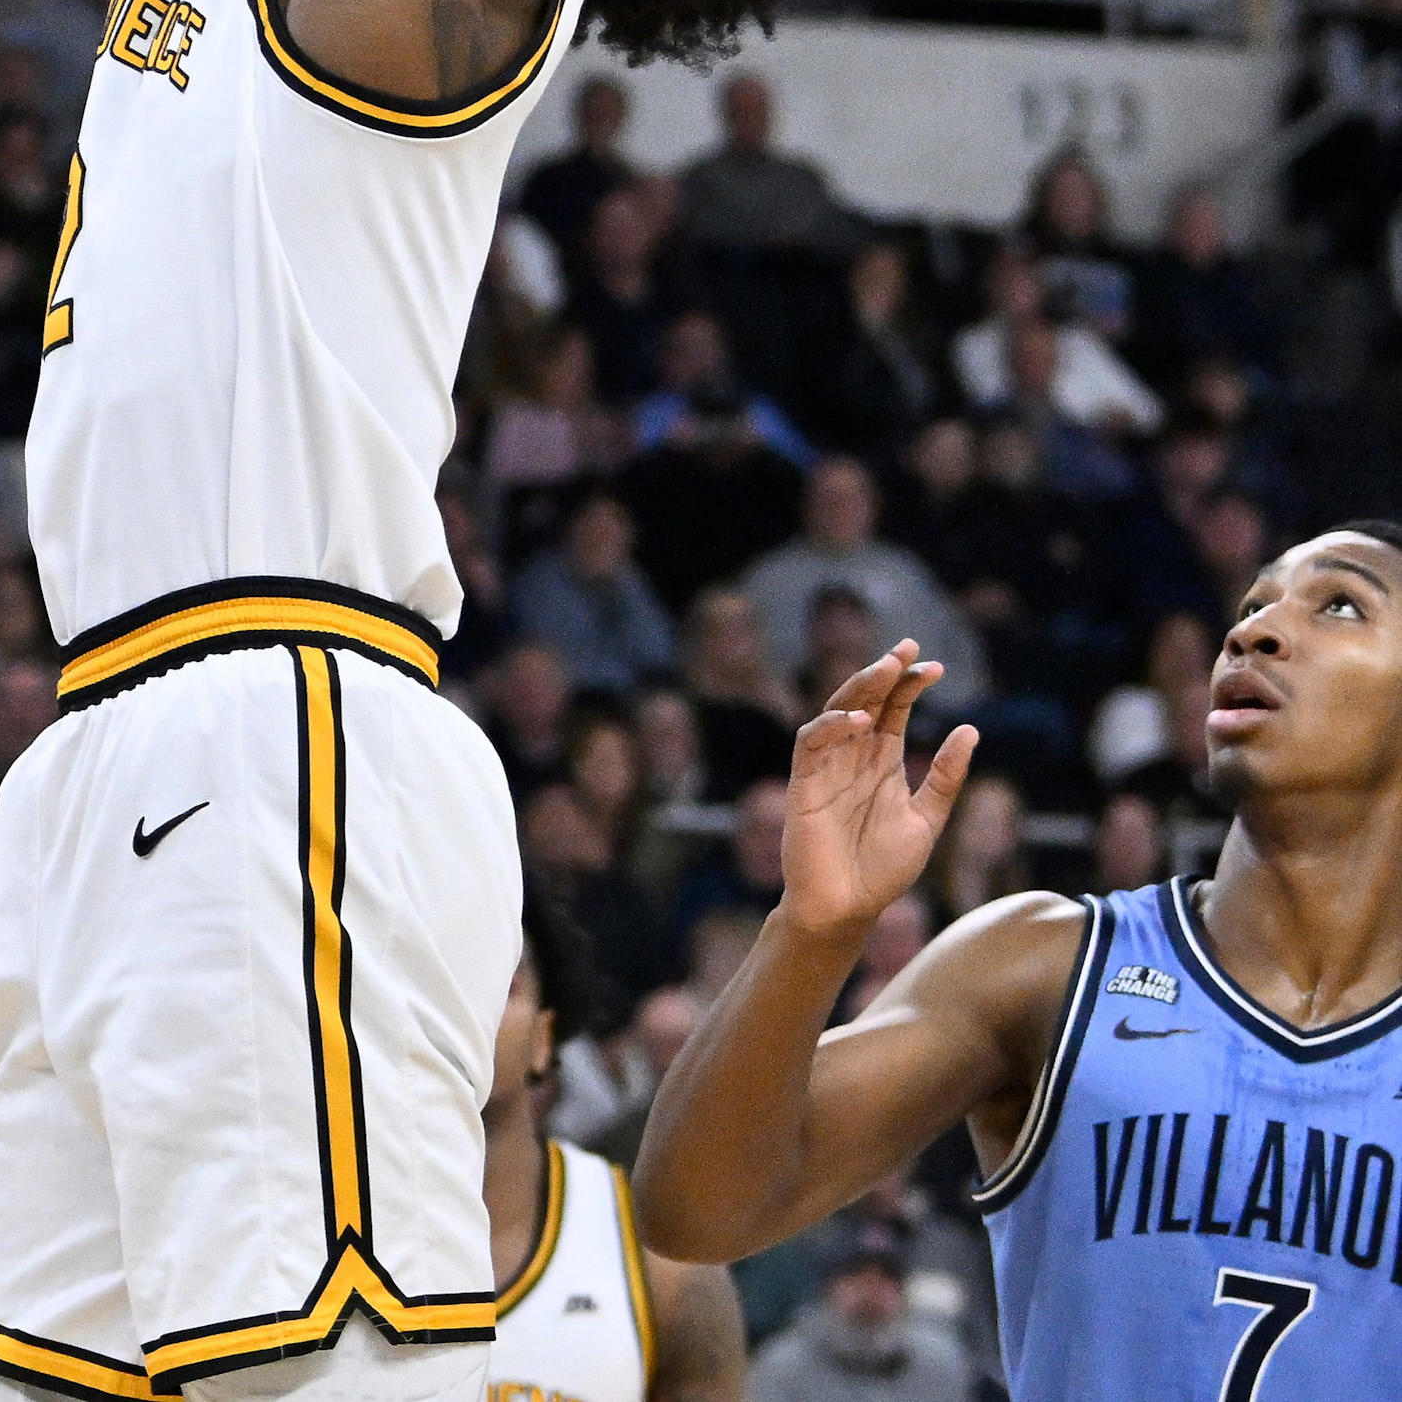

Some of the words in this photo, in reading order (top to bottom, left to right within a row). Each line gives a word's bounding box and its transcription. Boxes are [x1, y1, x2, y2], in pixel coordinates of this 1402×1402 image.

[1106, 977, 1178, 1005] CHANGE
[1117, 965, 1143, 981] BE
[1146, 968, 1177, 990] THE
[1094, 1112, 1402, 1285] VILLANO
[1213, 1266, 1318, 1402] 7
